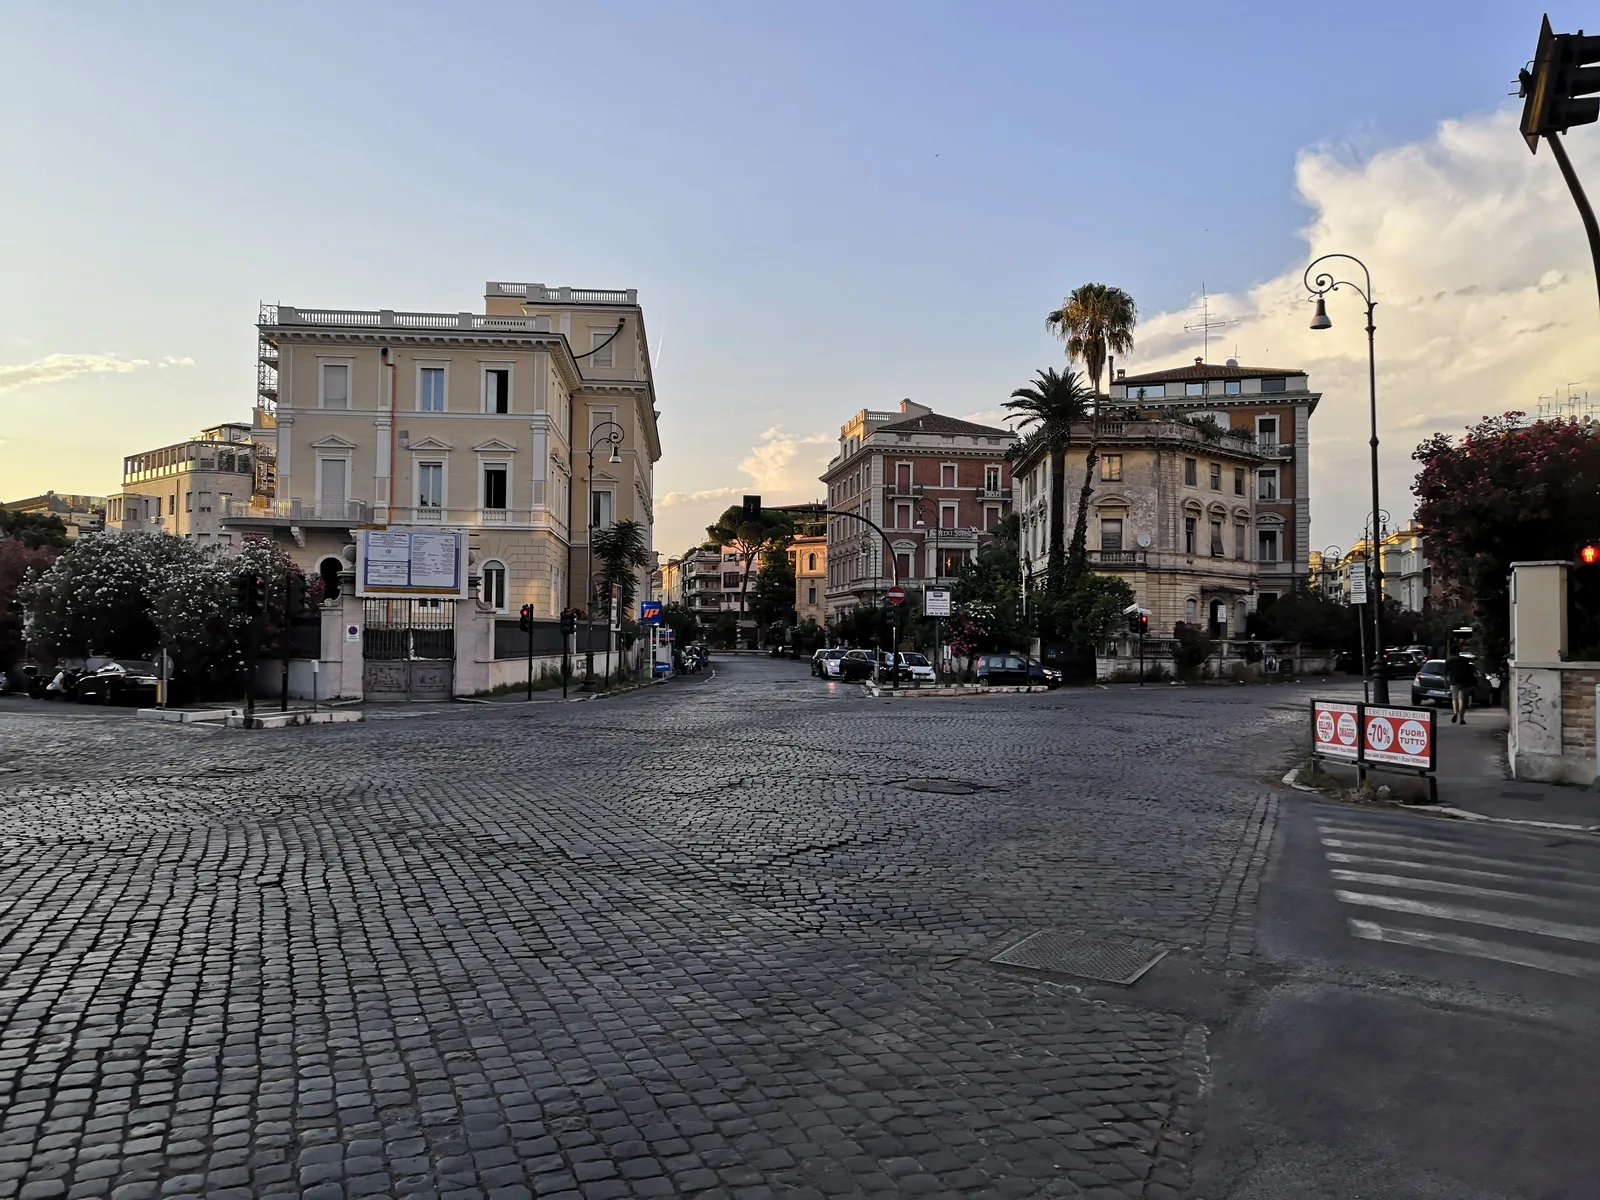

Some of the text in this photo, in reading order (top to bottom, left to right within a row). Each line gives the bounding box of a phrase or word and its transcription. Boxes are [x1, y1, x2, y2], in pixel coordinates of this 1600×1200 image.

[644, 608, 660, 618] IP
[1365, 707, 1430, 720] TESSUTI ARREDO ROMA
[1340, 727, 1355, 738] OMAGGIO
[1369, 724, 1391, 744] -70%
[1400, 728, 1425, 738] FUORI
[1399, 737, 1426, 746] TUTTO
